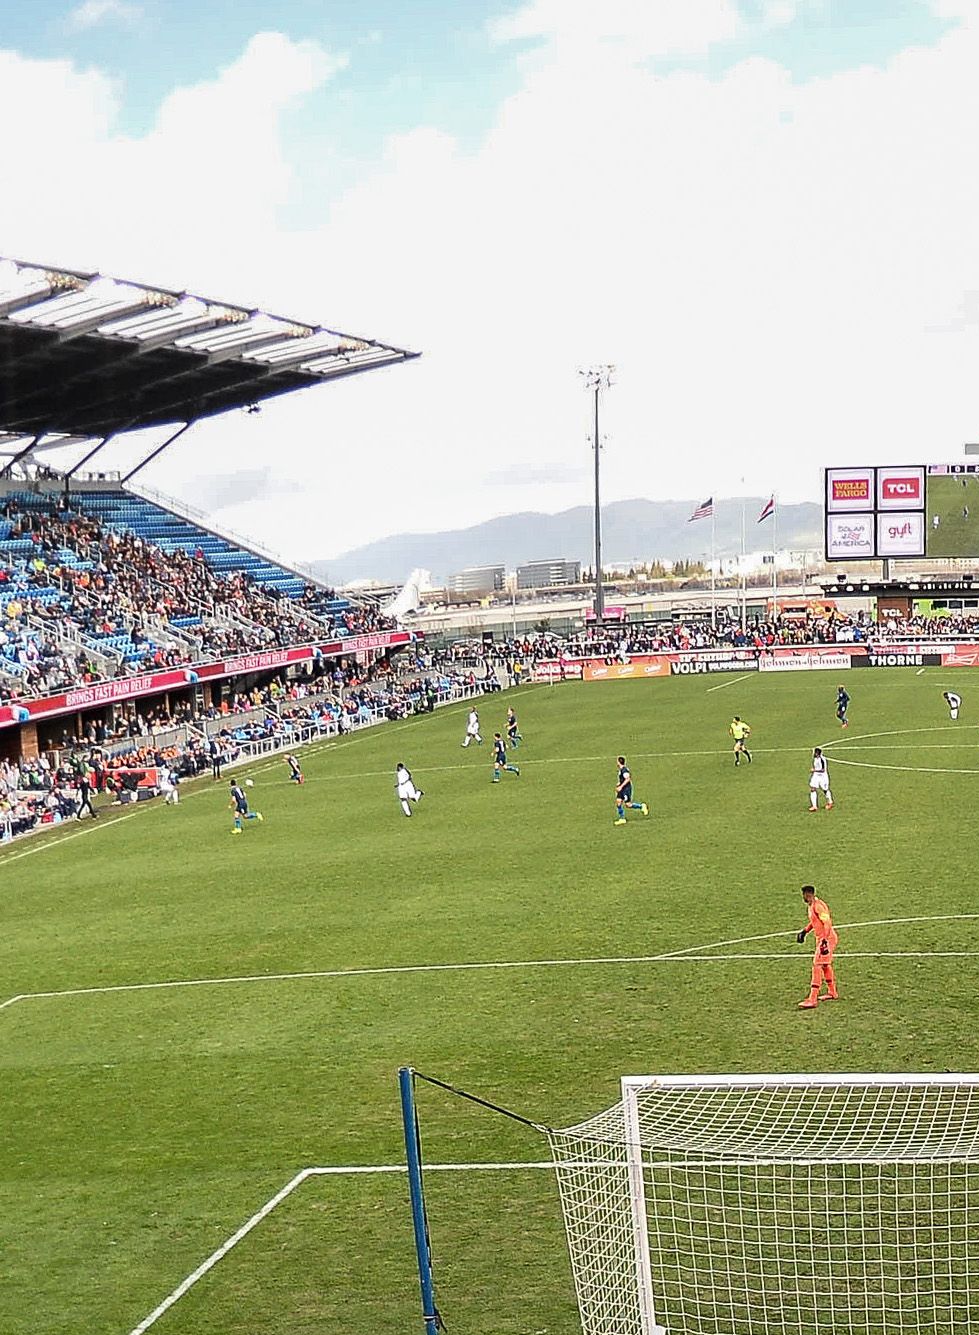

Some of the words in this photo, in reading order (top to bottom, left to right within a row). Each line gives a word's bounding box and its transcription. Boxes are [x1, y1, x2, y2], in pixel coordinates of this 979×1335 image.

[833, 481, 868, 490] WELLS
[887, 483, 915, 494] TCL
[835, 489, 868, 497] FARGO
[882, 609, 903, 617] TCL
[869, 655, 923, 666] THORNE
[672, 662, 707, 674] VOLPI
[66, 690, 94, 706] BRINGS
[95, 686, 112, 700] FAST
[113, 682, 130, 697] PAIN
[130, 677, 152, 693] RELIEF
